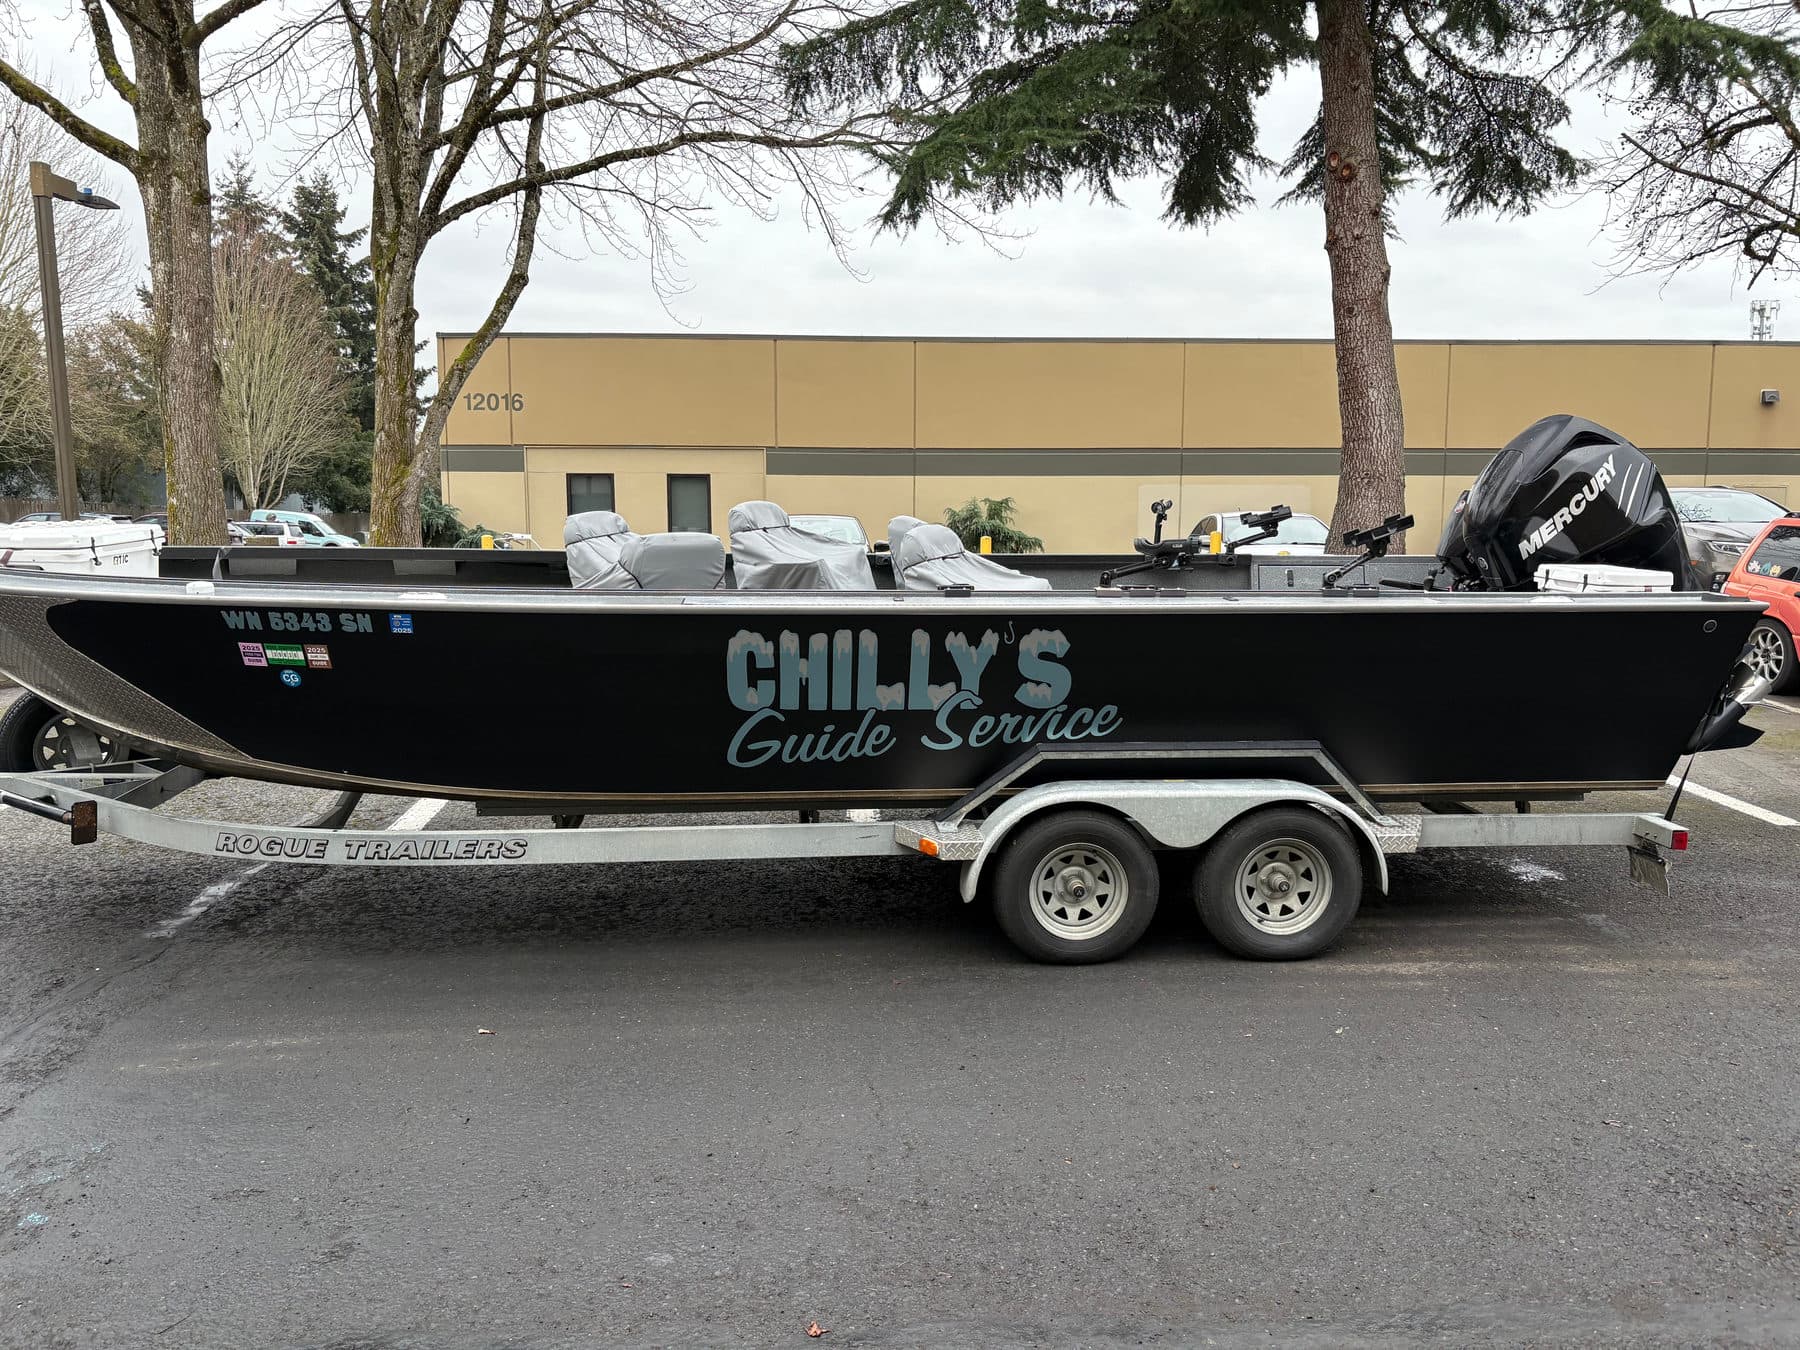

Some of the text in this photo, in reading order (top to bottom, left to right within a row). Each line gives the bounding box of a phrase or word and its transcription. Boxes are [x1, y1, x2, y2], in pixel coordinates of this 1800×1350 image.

[463, 392, 524, 412] 12016
[1517, 453, 1618, 560] MERCURY
[220, 610, 263, 631] WN
[339, 612, 374, 633] SN
[283, 673, 299, 682] CG
[726, 619, 1072, 711] CHILLY'S
[726, 690, 1123, 768] Guide Service
[215, 832, 528, 860] ROGUE TRAILERS
